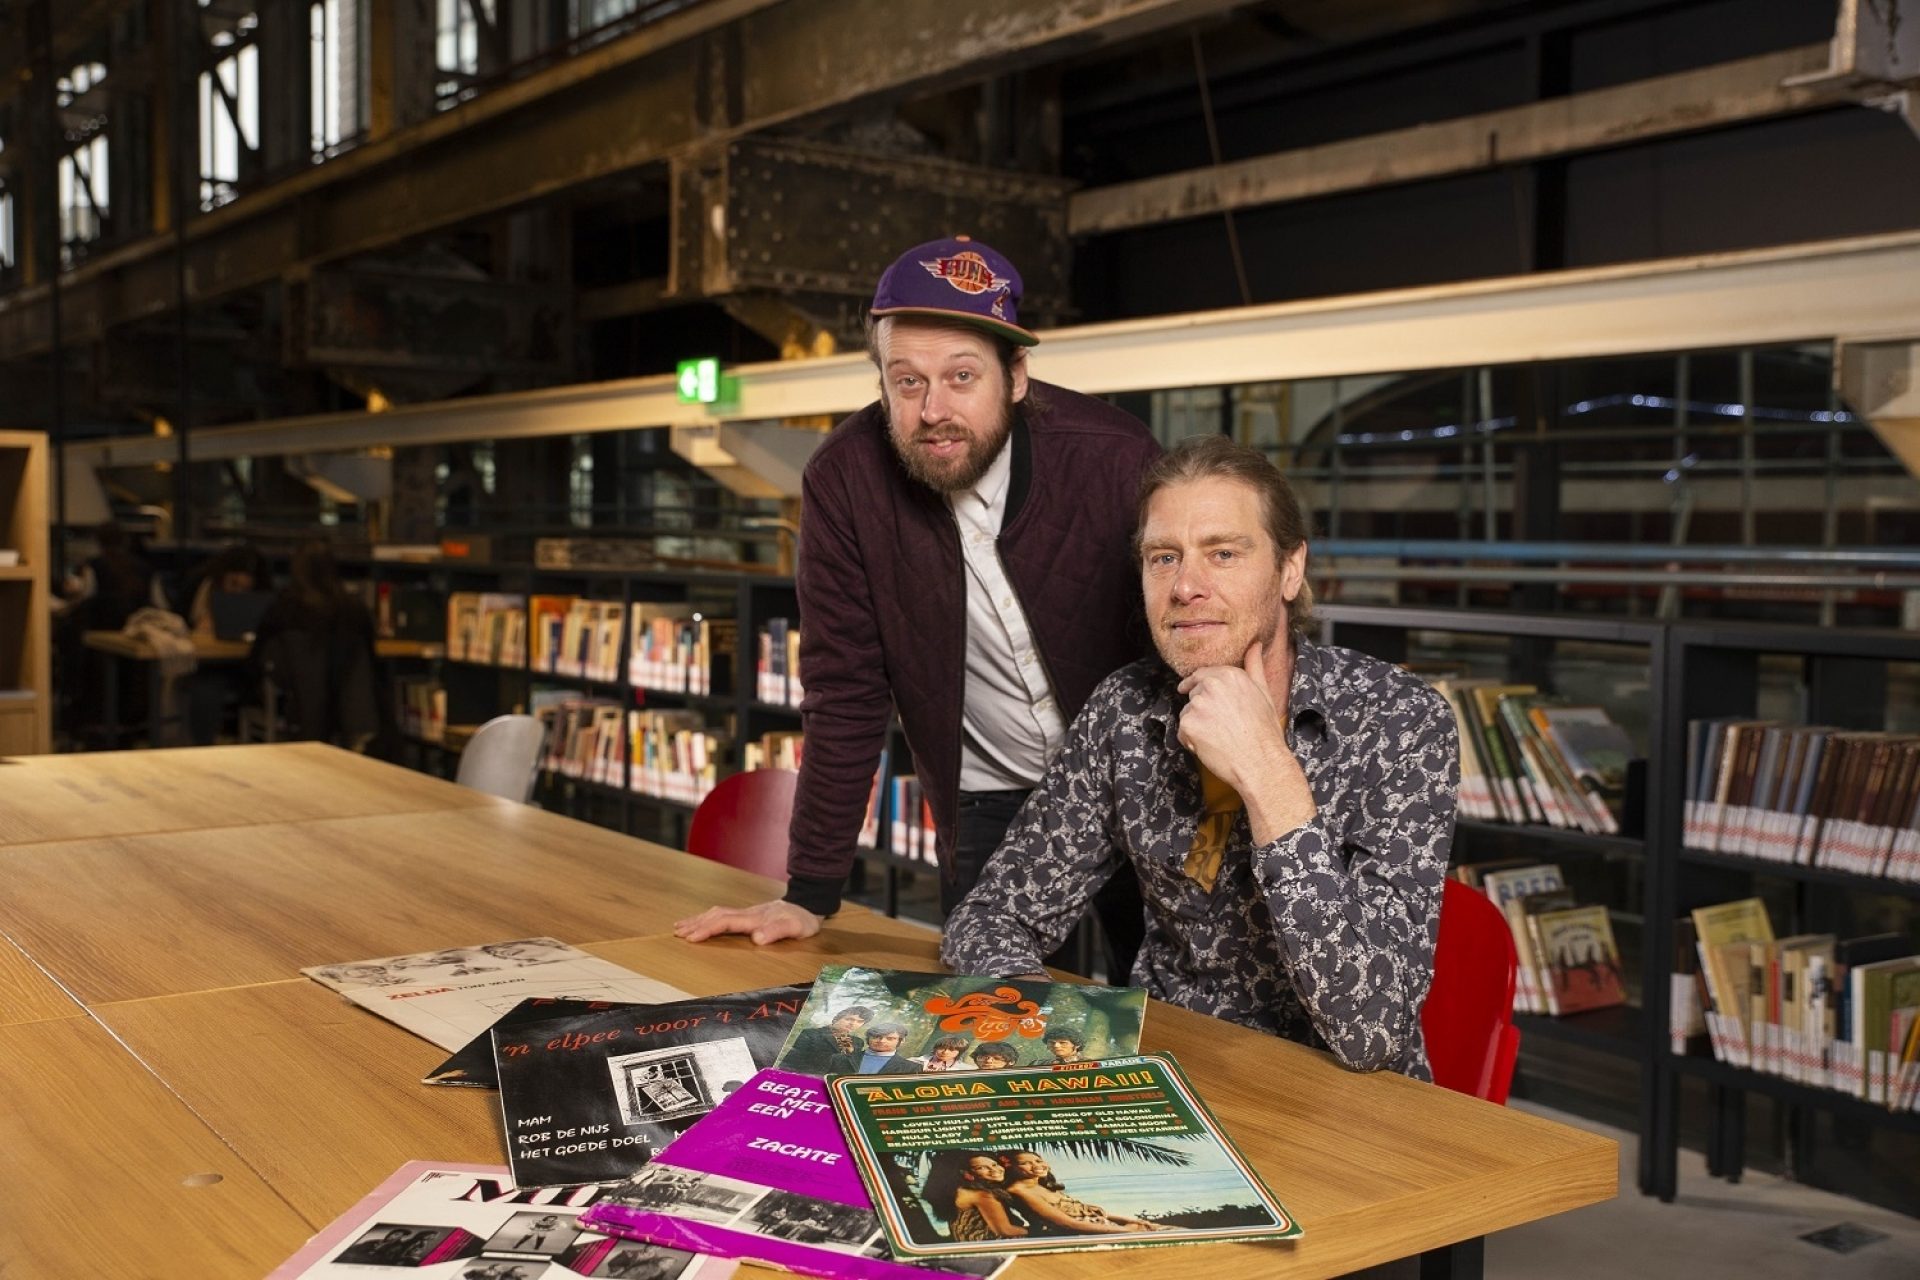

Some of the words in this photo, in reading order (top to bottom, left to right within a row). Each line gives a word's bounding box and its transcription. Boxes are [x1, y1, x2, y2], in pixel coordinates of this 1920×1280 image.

[547, 1029, 621, 1051] elpee
[635, 1015, 706, 1037] voor
[745, 999, 805, 1020] AN
[757, 1080, 818, 1100] BEAT
[867, 1082, 996, 1102] ALOHA
[1007, 1071, 1155, 1093] HAWAII!
[747, 1102, 794, 1119] EEN
[780, 1097, 831, 1114] MET
[517, 1115, 552, 1128] MAM
[881, 1127, 932, 1135] HARBOUR
[932, 1124, 969, 1132] LIGHTS
[902, 1119, 942, 1128] LOVELY
[987, 1120, 1022, 1128] LITTLE
[518, 1132, 551, 1144] ROB
[556, 1128, 576, 1139] DE
[580, 1123, 610, 1137] NIJS
[989, 1126, 1034, 1135] JUMPING
[520, 1148, 550, 1160] HET
[555, 1140, 607, 1156] GOEDE
[612, 1134, 651, 1148] DOEL
[747, 1137, 842, 1165] ZACHTE
[887, 1140, 945, 1148] BEAUTIFUL
[946, 1137, 984, 1145] ISLAND
